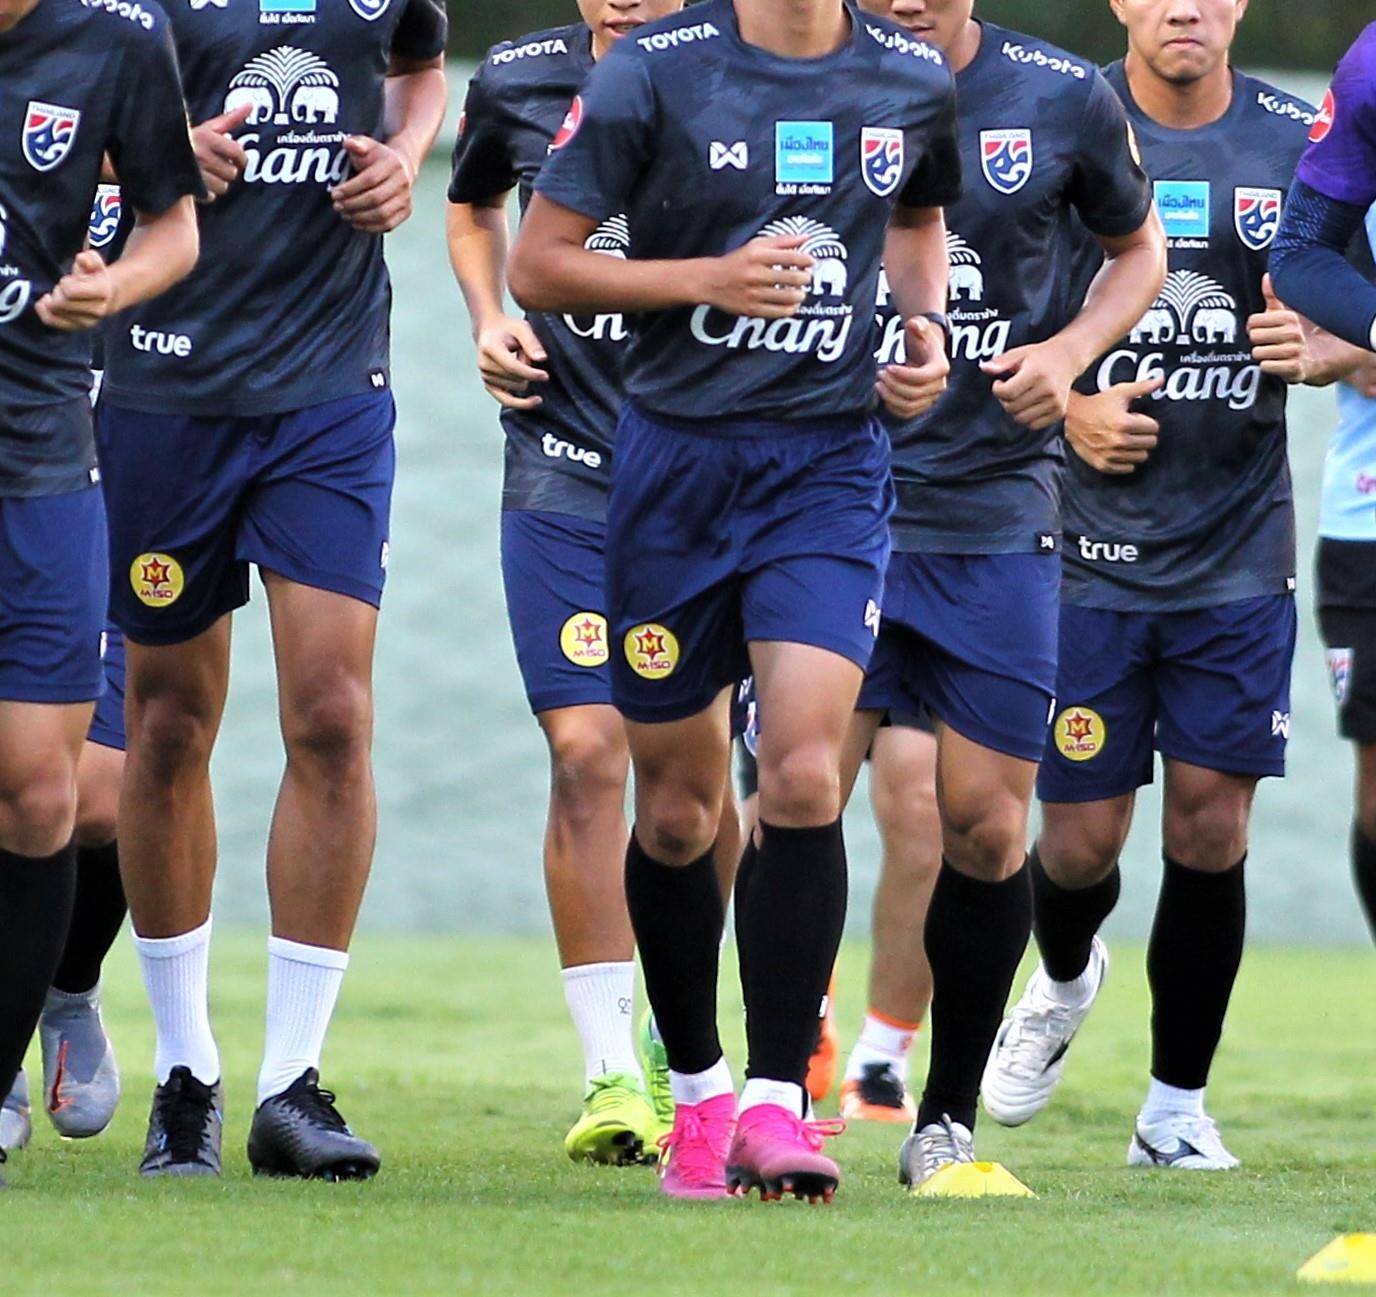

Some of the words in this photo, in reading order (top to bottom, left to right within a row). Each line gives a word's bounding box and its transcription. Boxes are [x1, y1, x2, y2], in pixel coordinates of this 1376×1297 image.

[492, 39, 567, 65] TOYOTA
[637, 23, 719, 51] TOYOTA
[866, 22, 942, 65] Kubota
[1003, 42, 1085, 78] Kubota
[32, 104, 76, 119] THAILAND
[1258, 91, 1316, 124] Kubo
[224, 130, 354, 191] hang
[131, 325, 191, 356] true
[874, 306, 1010, 363] Chng
[1097, 350, 1258, 410] Chang
[542, 433, 601, 467] true
[1079, 536, 1138, 561] true
